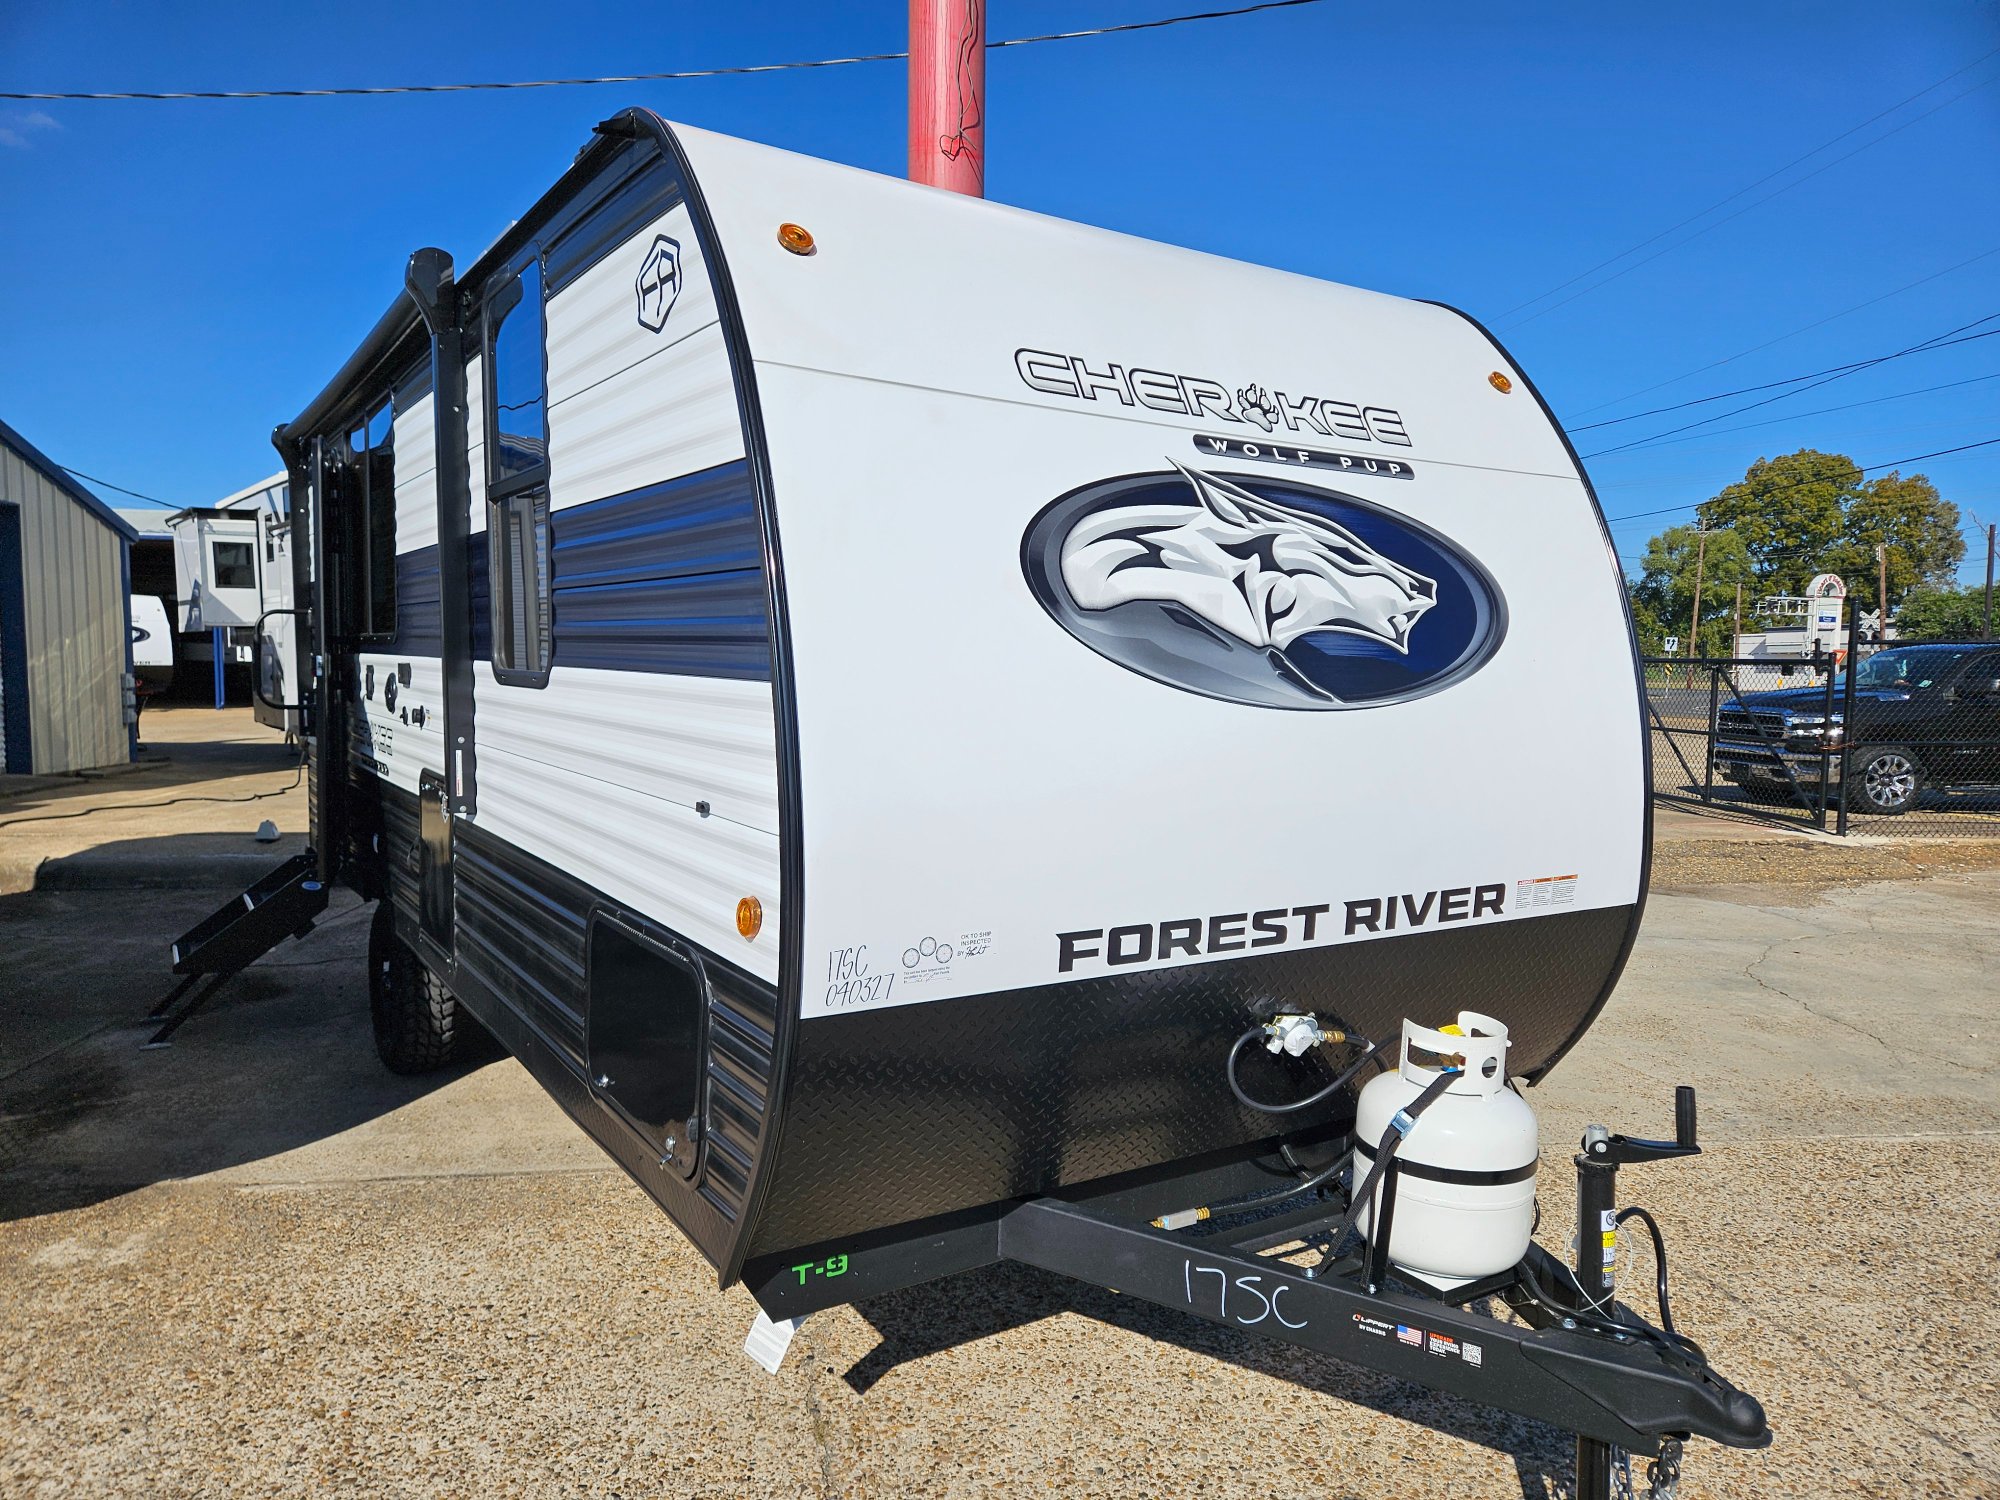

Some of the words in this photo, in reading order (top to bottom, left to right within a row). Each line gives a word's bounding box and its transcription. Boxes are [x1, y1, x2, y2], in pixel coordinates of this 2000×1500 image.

[1208, 438, 1310, 465] WOLF
[1339, 456, 1402, 476] PUP
[960, 938, 992, 946] INSPECTED
[1056, 903, 1330, 973] FOREST
[1343, 883, 1506, 936] RIVER
[825, 973, 895, 1007] 040327
[791, 1254, 849, 1286] T-9
[1360, 1316, 1395, 1330] LIPPERT
